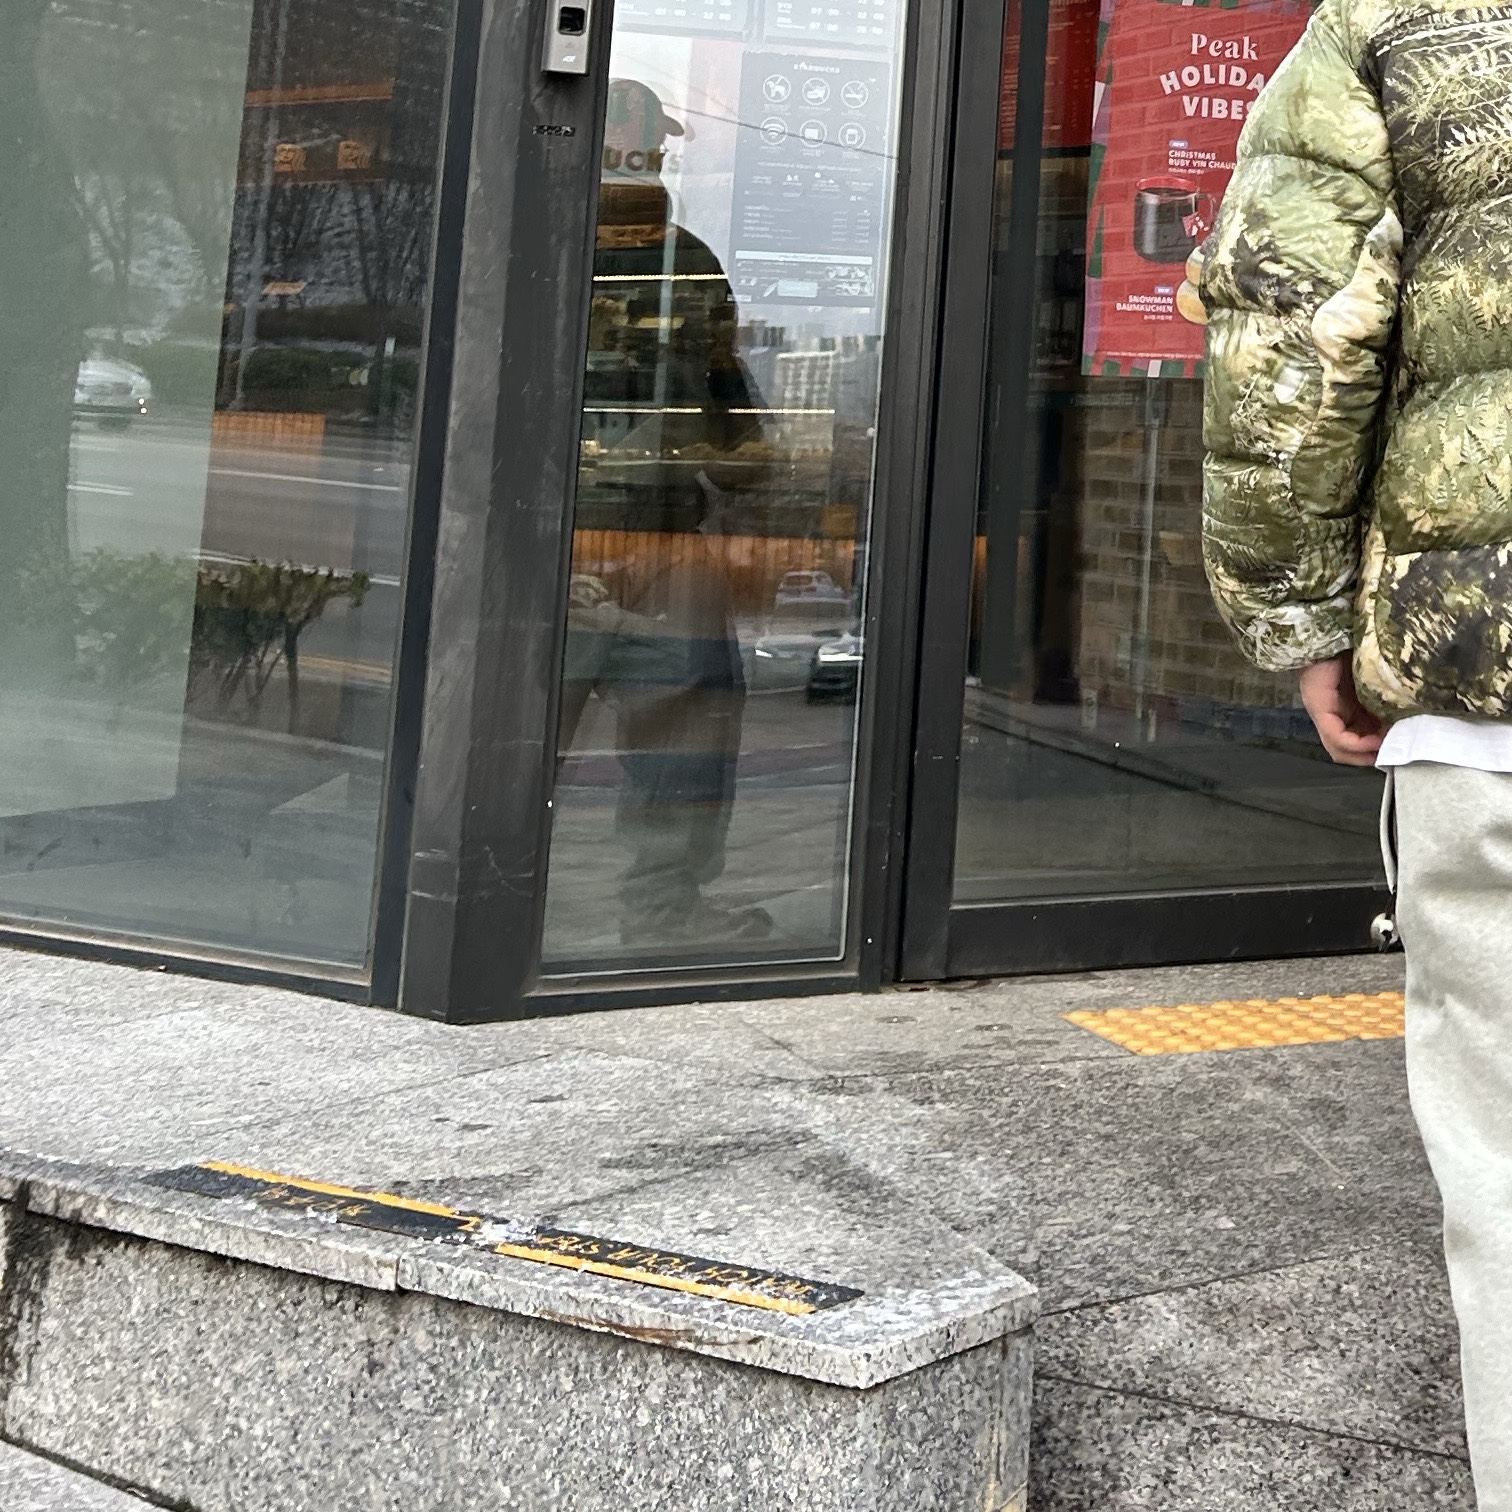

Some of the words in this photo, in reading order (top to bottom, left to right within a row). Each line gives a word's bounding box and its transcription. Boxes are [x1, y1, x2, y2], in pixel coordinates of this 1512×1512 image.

[1191, 33, 1258, 60] Peak
[1160, 64, 1265, 95] HOLIDA
[1168, 150, 1216, 160] CHRISTMAS
[1168, 158, 1191, 167] RUBY
[1128, 295, 1173, 304] SNOWMAN
[1116, 303, 1173, 313] BAUMKUCHEN
